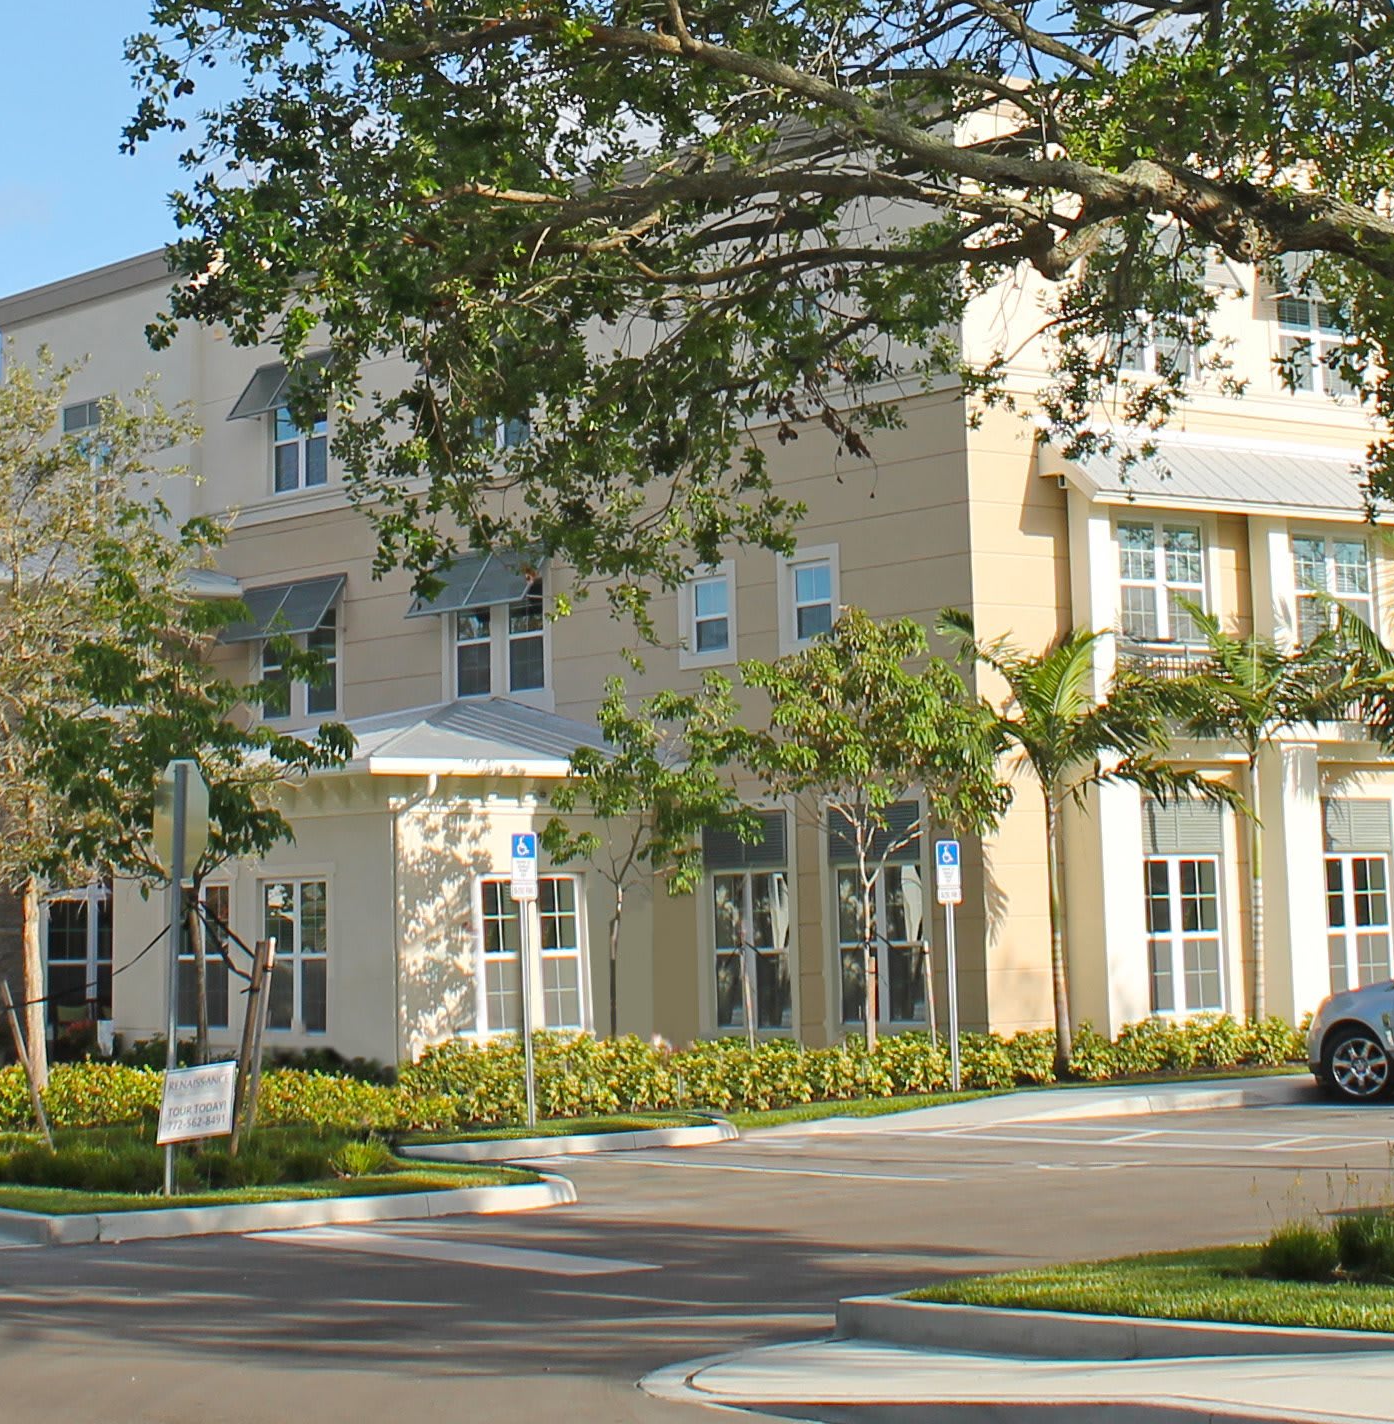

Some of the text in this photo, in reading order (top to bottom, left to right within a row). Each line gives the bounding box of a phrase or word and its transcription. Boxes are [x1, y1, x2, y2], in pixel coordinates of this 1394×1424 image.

[168, 1100, 226, 1117] TOUR TODAY!
[167, 1114, 225, 1130] 772-562-8491
